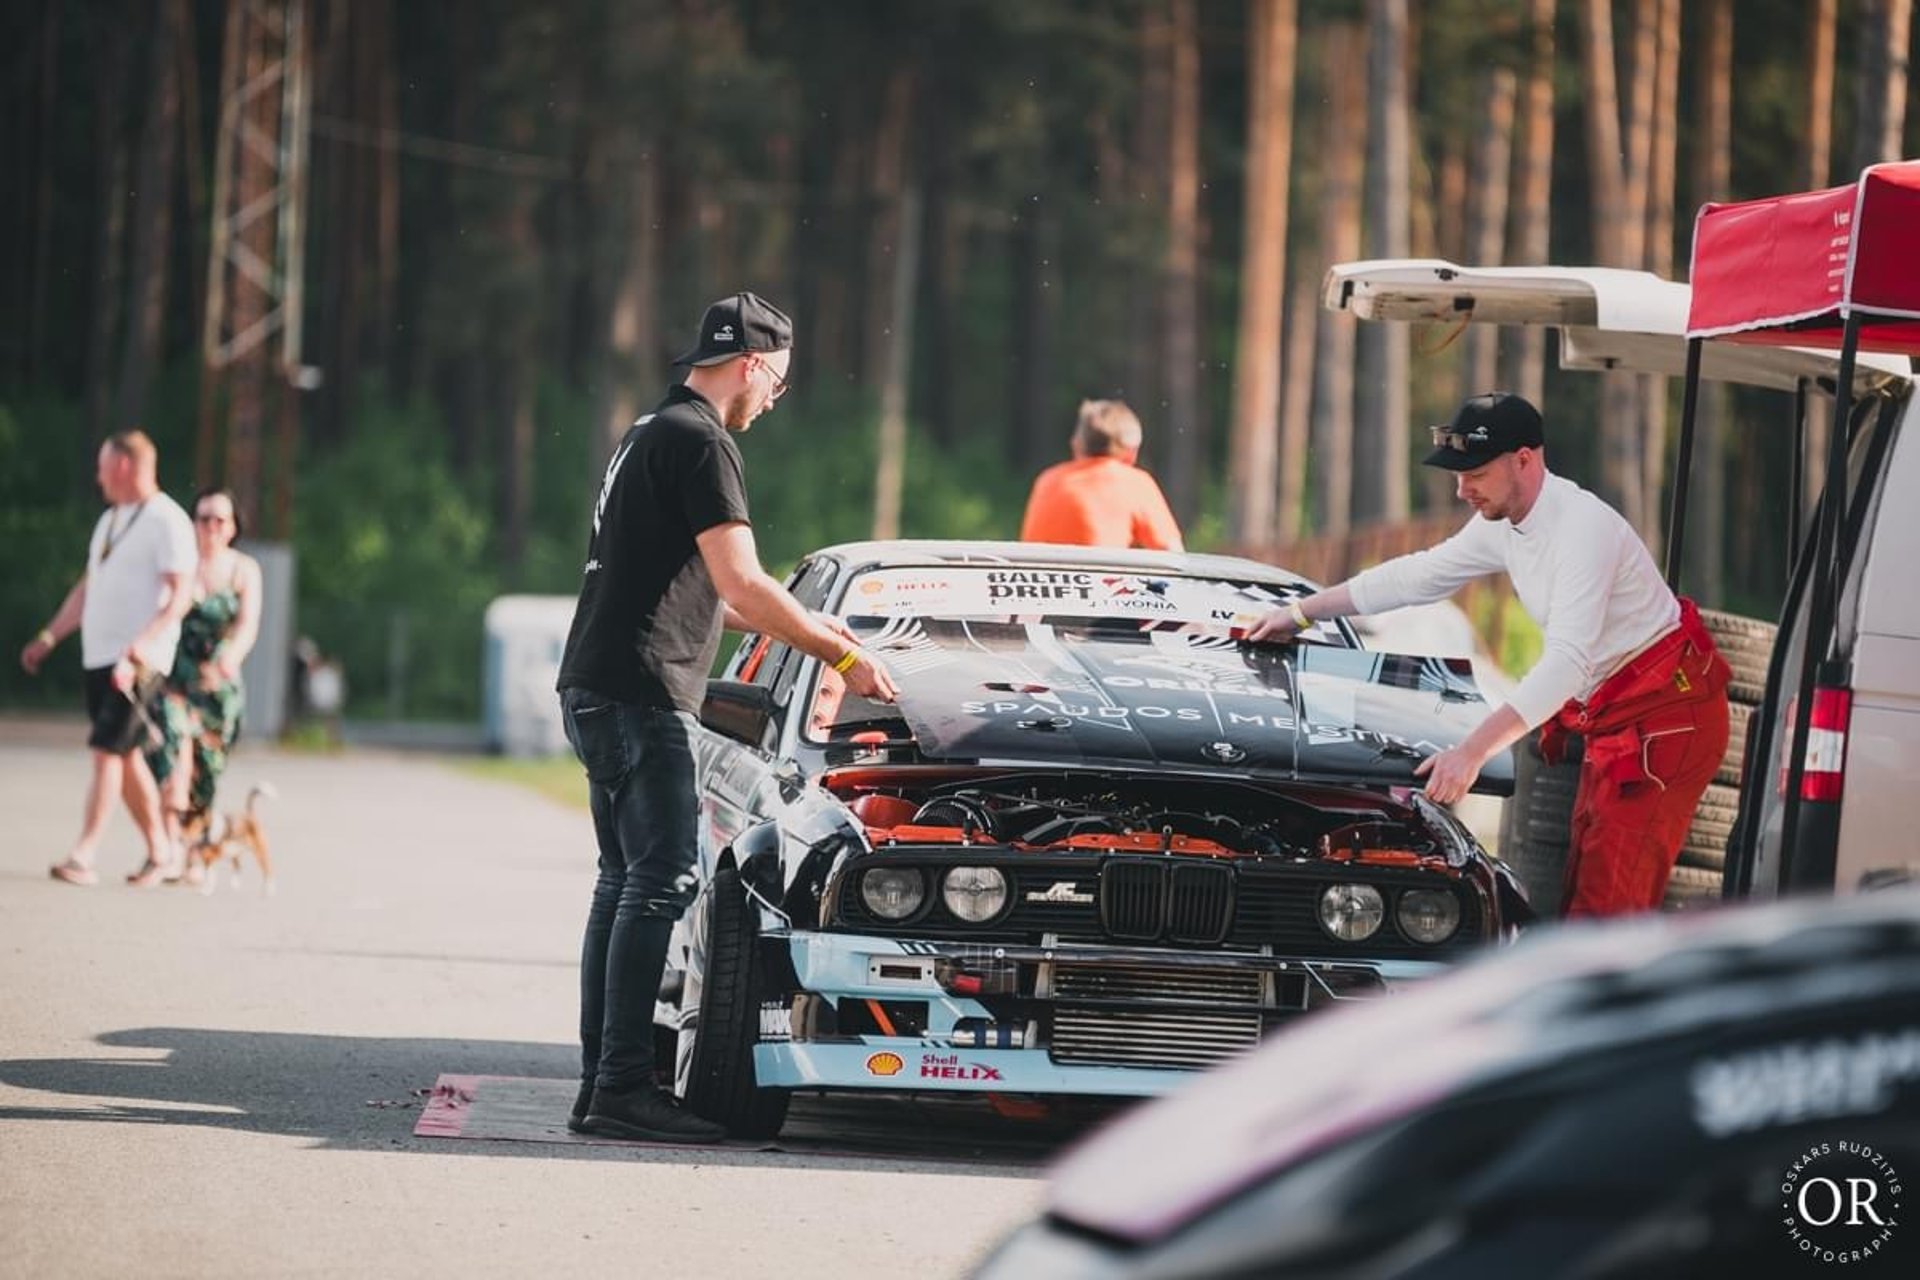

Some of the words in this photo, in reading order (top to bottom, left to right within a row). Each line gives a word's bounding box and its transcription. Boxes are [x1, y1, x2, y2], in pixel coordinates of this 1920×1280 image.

[986, 572, 1092, 585] BALTIC
[988, 585, 1094, 600] DRIFT
[960, 701, 1202, 721] SPAUDOS
[922, 1054, 959, 1066] Shell
[921, 1065, 1003, 1081] HELIX
